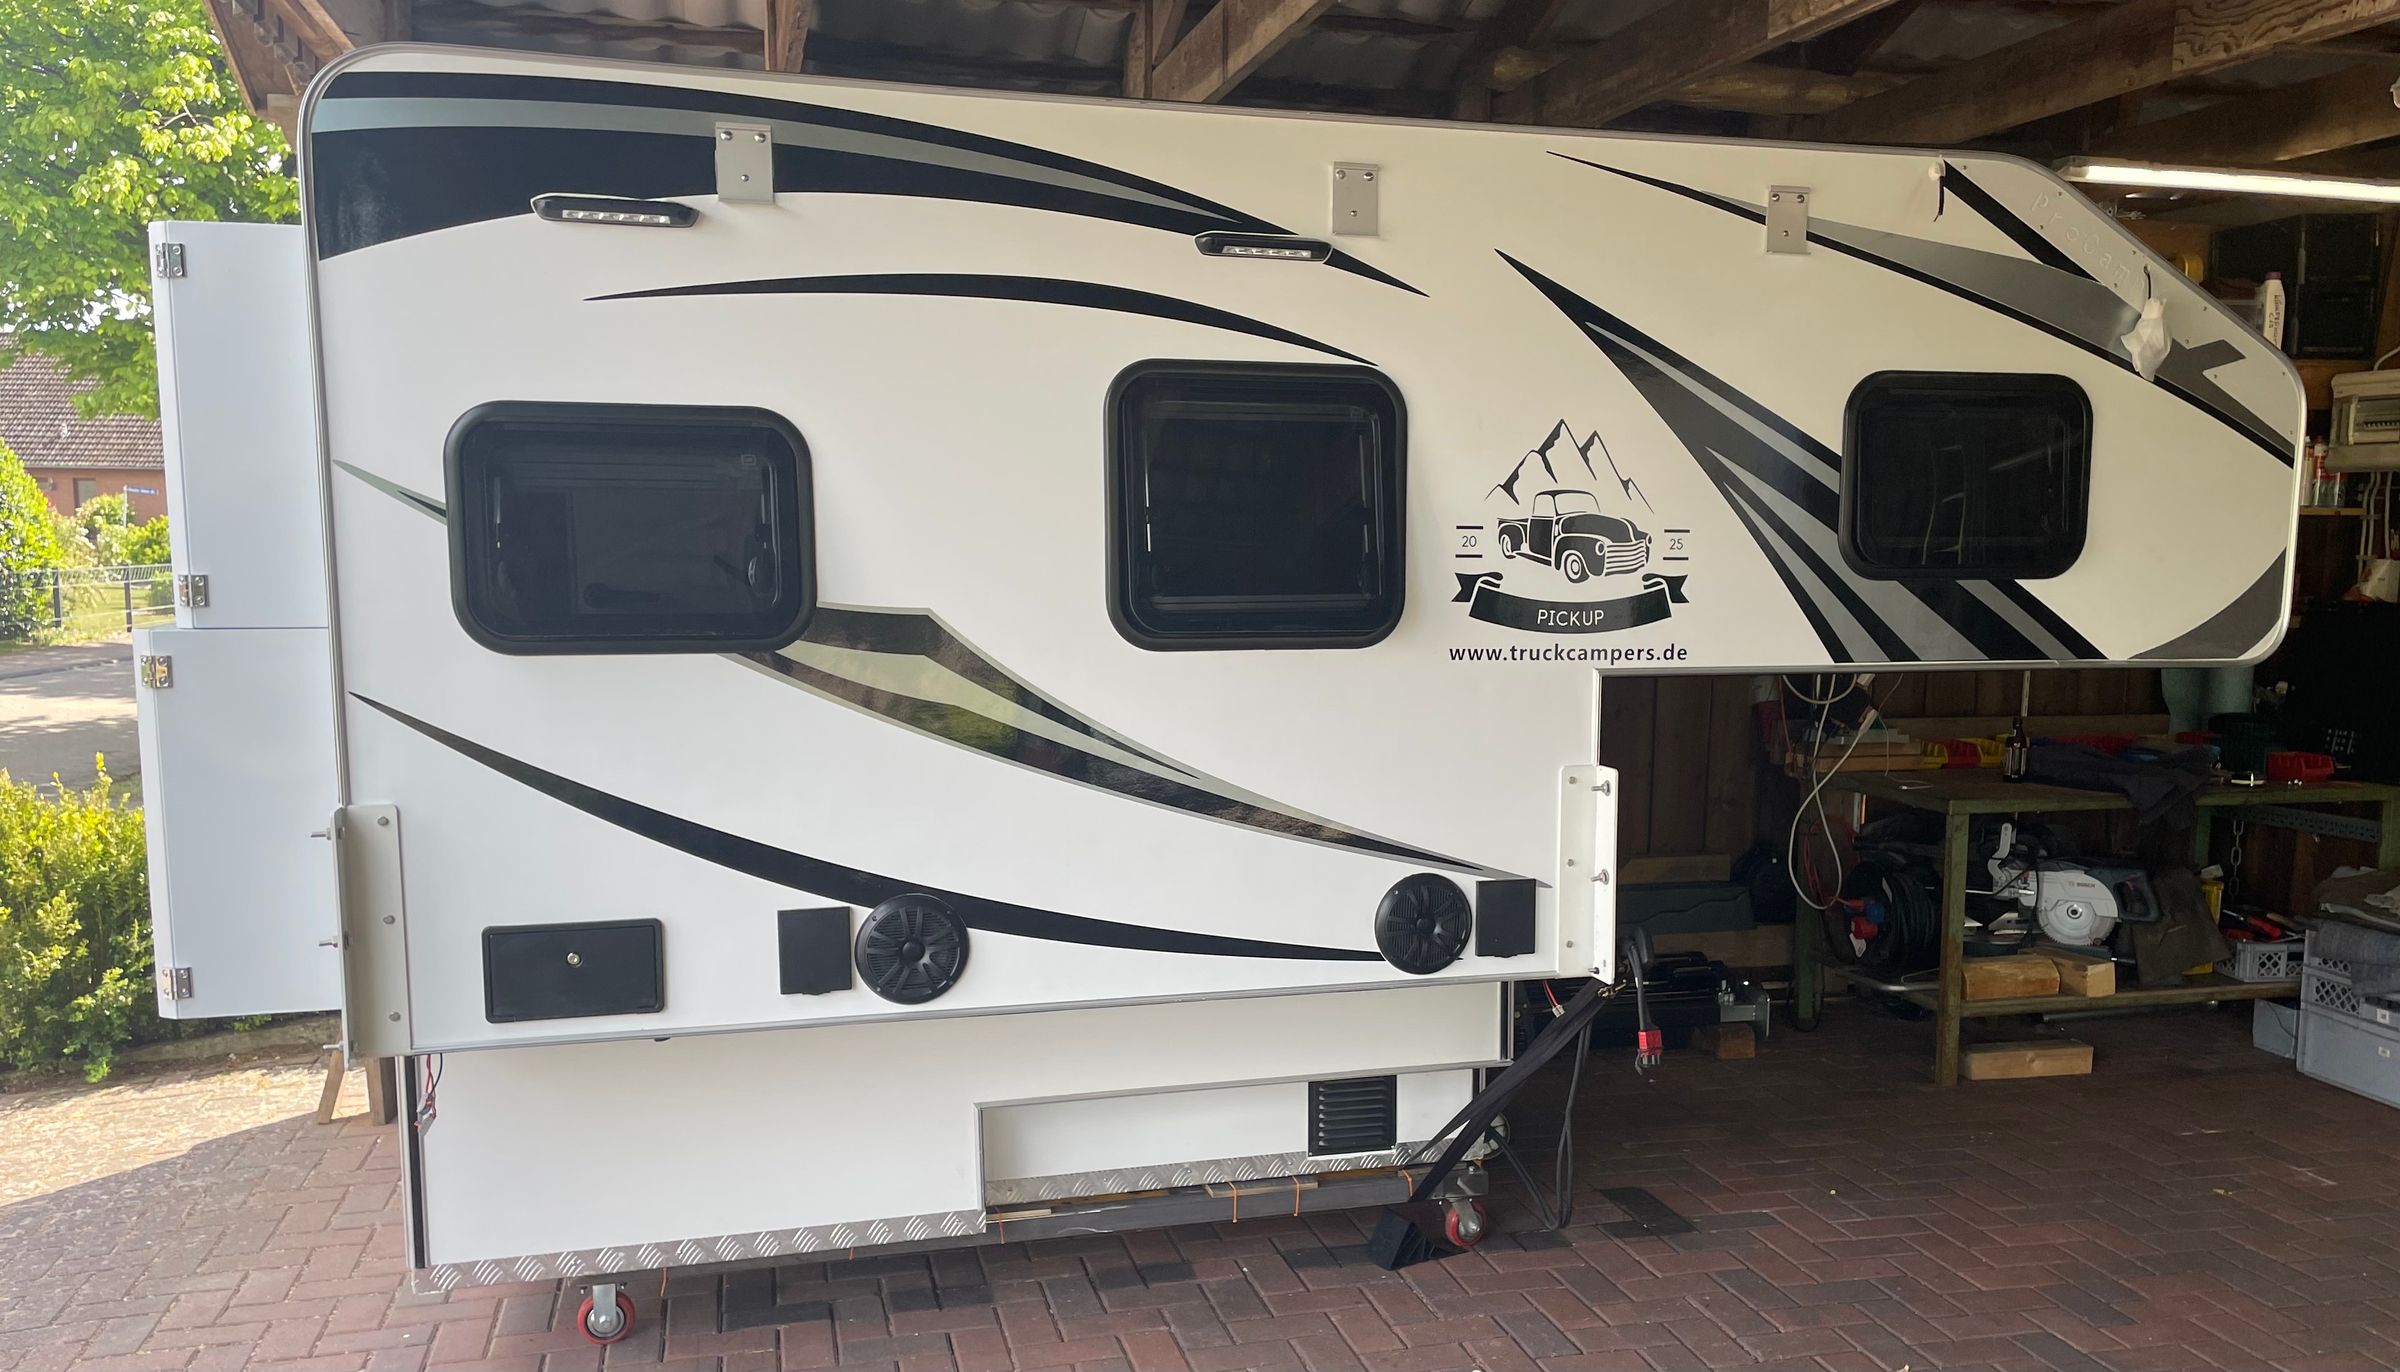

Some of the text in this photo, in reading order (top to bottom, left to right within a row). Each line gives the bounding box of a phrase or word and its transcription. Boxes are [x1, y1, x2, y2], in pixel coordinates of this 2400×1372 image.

[1461, 535, 1684, 551] 20 25
[1537, 609, 1605, 627] PICKUP
[1449, 643, 1688, 666] www.truckcampers.de
